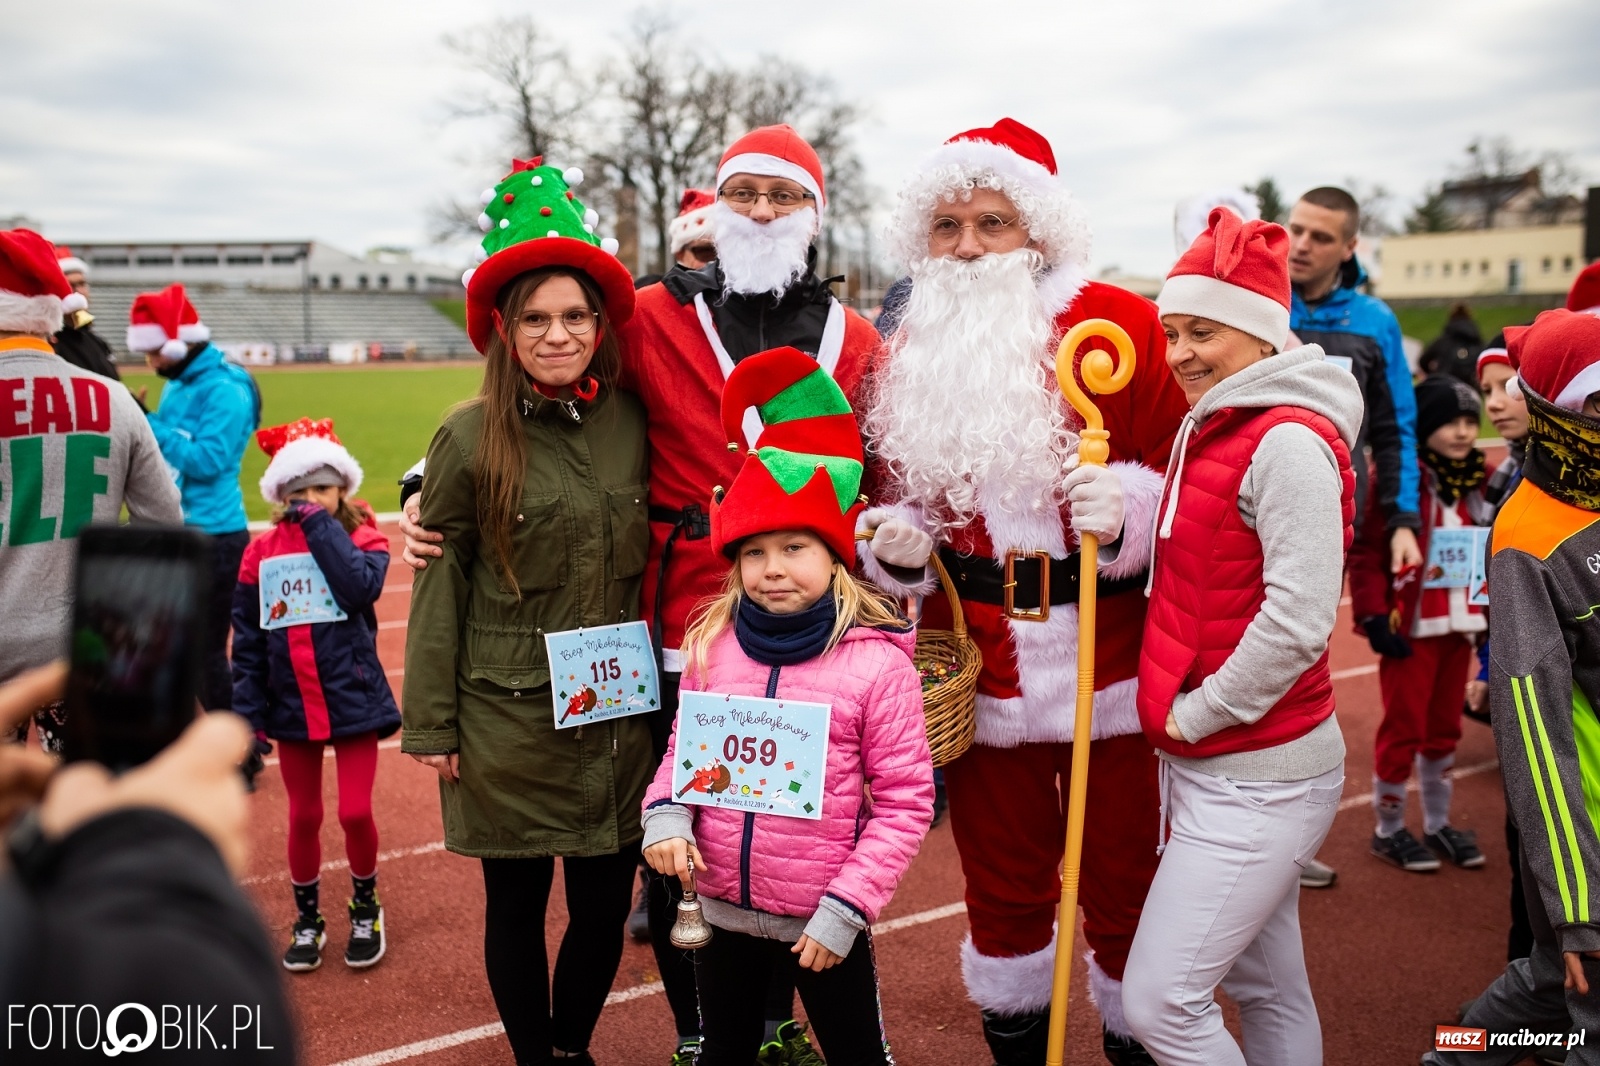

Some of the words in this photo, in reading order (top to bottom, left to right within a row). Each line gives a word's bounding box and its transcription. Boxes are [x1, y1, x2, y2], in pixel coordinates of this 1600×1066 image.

[0, 433, 111, 547] LF
[1438, 547, 1467, 564] 155
[281, 578, 312, 596] 041
[590, 657, 621, 683] 115
[694, 713, 726, 727] Bieg
[723, 734, 777, 766] 059
